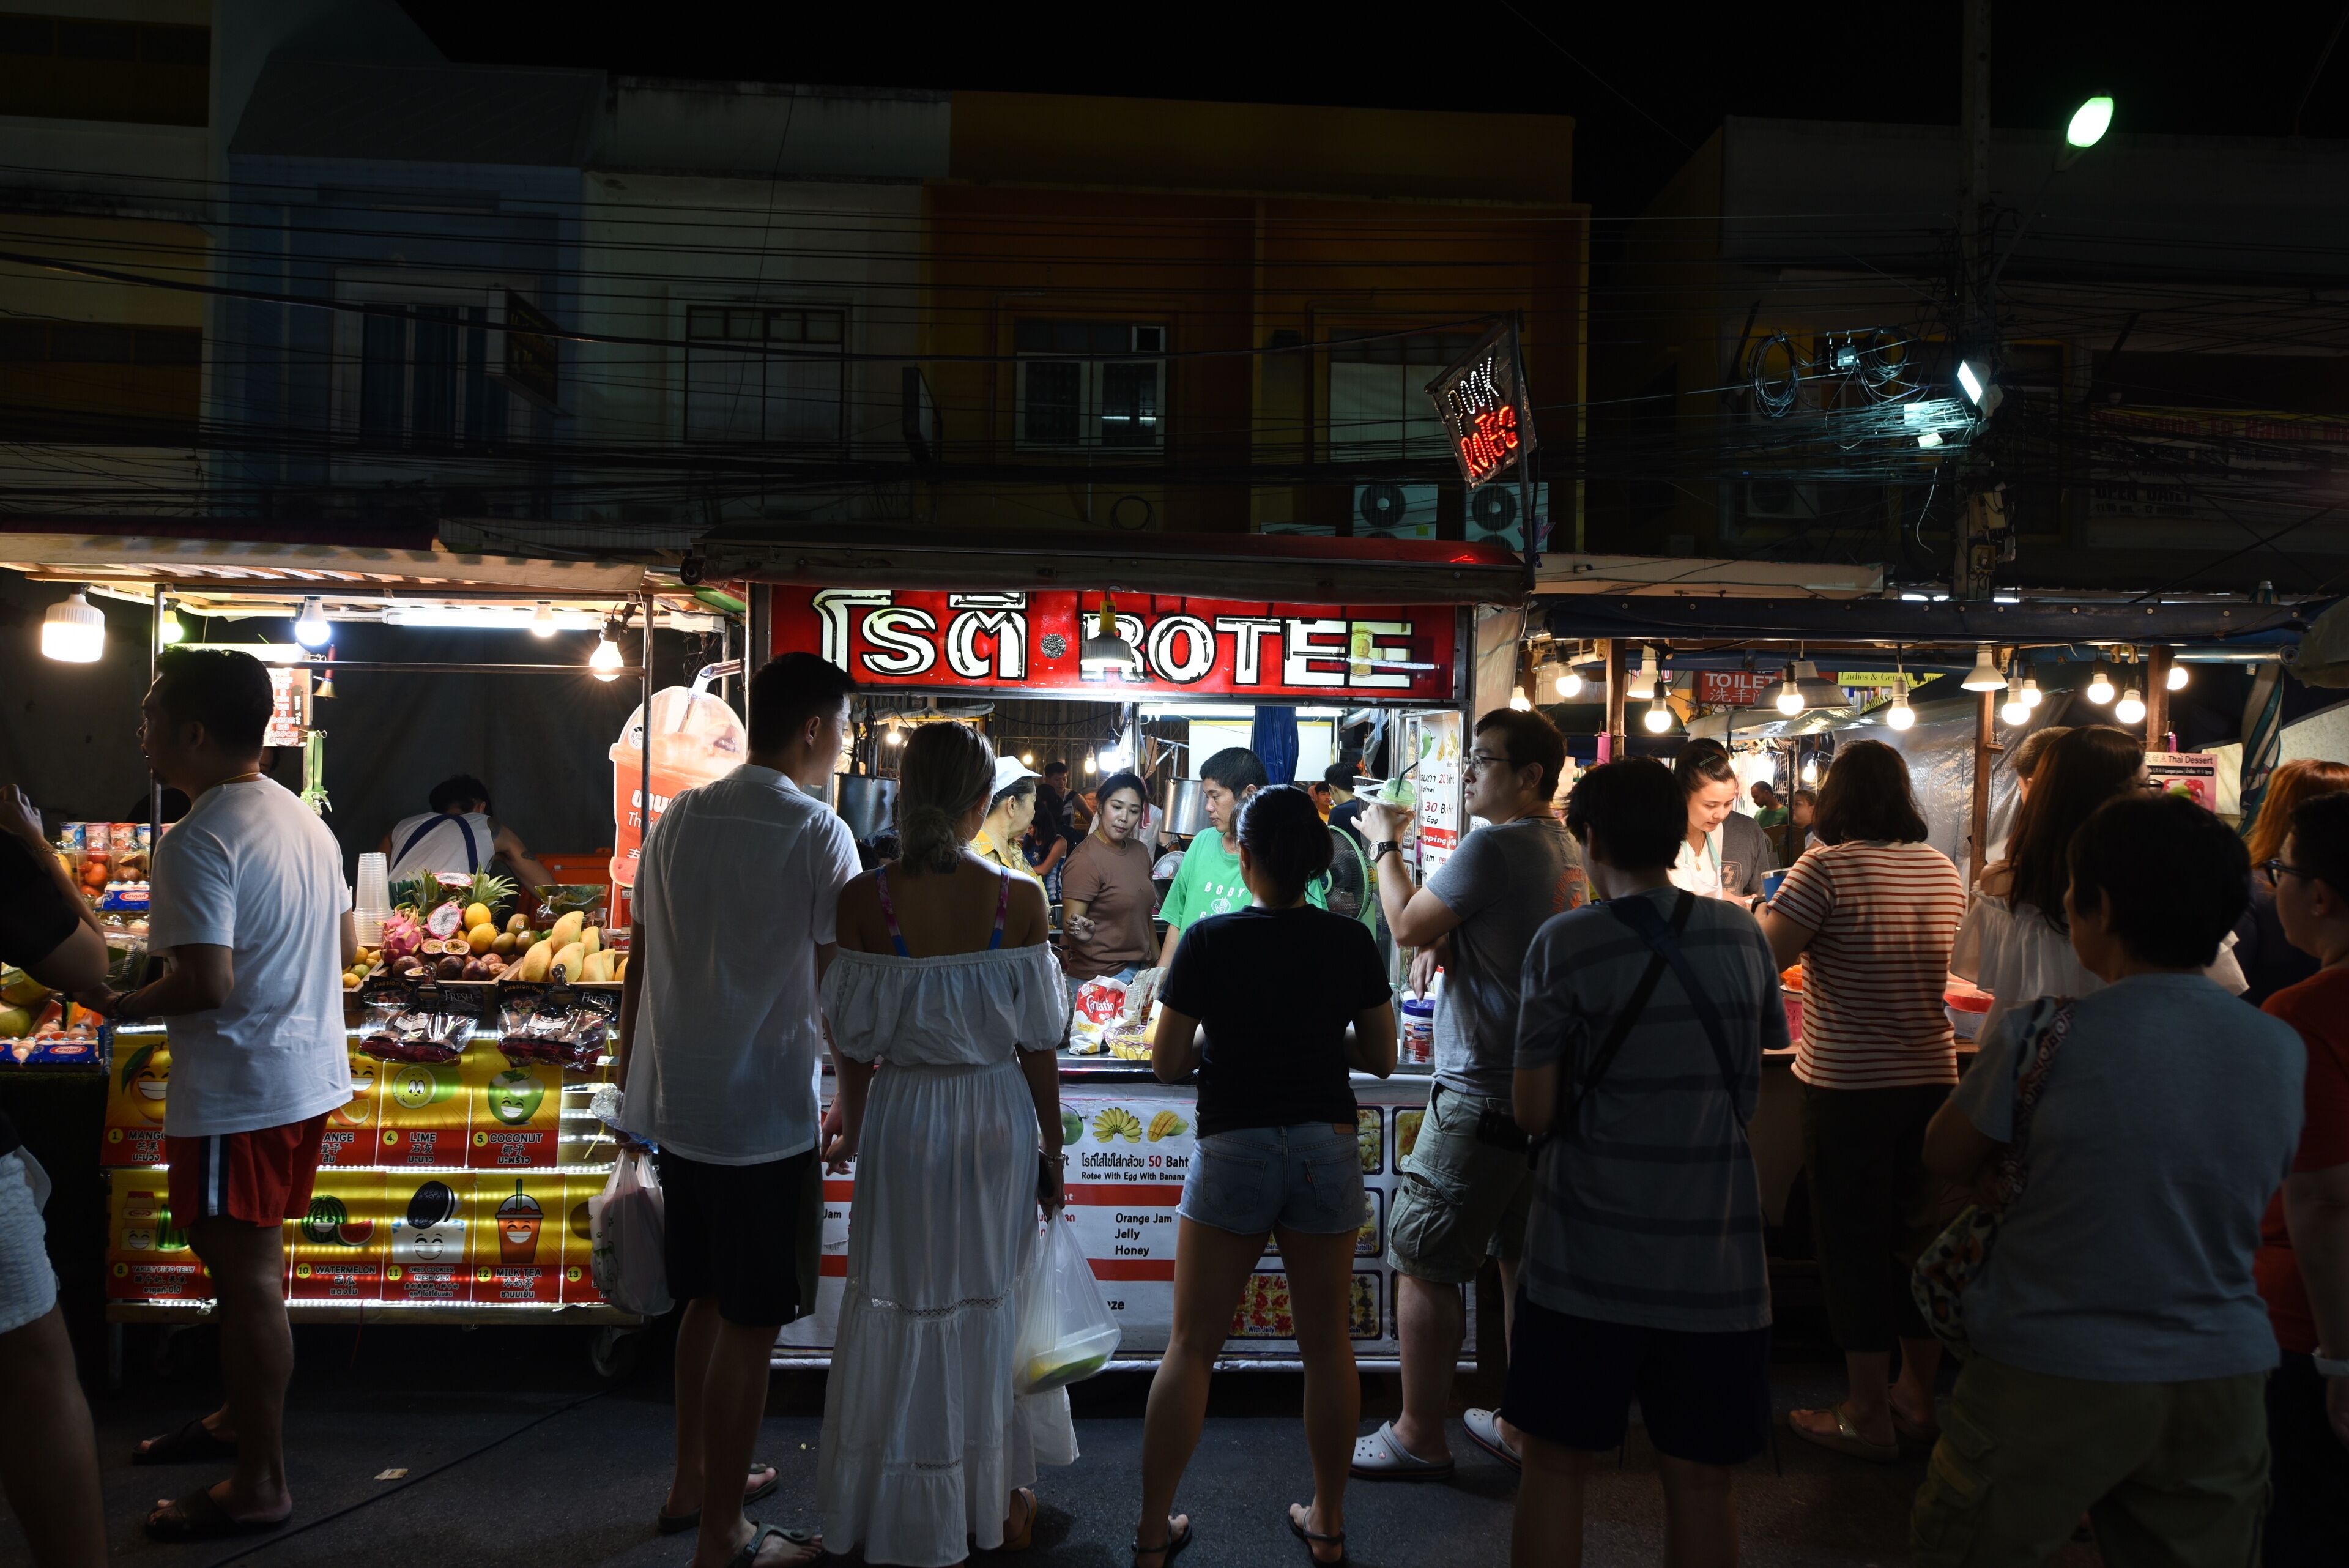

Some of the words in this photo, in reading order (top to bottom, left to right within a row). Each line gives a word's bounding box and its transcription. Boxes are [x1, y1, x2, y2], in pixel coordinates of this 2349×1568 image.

[1080, 611, 1414, 687] ROTEE
[1705, 673, 1777, 689] TOILET
[1841, 672, 1868, 680] Ladies
[1425, 801, 1438, 812] 30
[628, 811, 654, 830] Thi
[1427, 816, 1438, 825] Egg
[1204, 882, 1245, 898] BODY
[400, 982, 413, 993] fruit
[503, 984, 533, 992] passion
[532, 984, 545, 995] fruit
[444, 990, 475, 1002] FRESH
[581, 992, 613, 1006] FRESH
[112, 1131, 120, 1140] 1.
[322, 1132, 354, 1143] ANGE
[386, 1133, 395, 1142] 4.
[409, 1132, 437, 1143] LIME
[477, 1134, 485, 1143] 5.
[489, 1133, 543, 1143] COCONUT
[136, 1141, 159, 1153] 芒果
[410, 1143, 434, 1154] 石灰
[501, 1143, 525, 1156] 椰子
[407, 1155, 436, 1164] มะนาว
[497, 1154, 531, 1165] มะพร้าว
[1148, 1155, 1162, 1167] 50
[1165, 1155, 1189, 1168] Baht
[1124, 1172, 1137, 1181] Egg
[824, 1209, 842, 1219] Jam
[1115, 1213, 1149, 1225] Orange
[1153, 1213, 1172, 1224] Jam
[1115, 1228, 1140, 1241] Jelly
[1115, 1245, 1149, 1257] Honey
[117, 1265, 125, 1274] 8.
[315, 1265, 376, 1274] WATERMELON
[478, 1269, 491, 1278] 12.
[495, 1267, 521, 1277] MILK
[522, 1267, 542, 1277] TEA
[568, 1269, 581, 1279] 13.
[334, 1275, 357, 1285] 西瓜
[503, 1277, 534, 1288] 冷奶茶
[330, 1285, 358, 1296] แตงโม
[500, 1288, 535, 1299] ชานมเย็น
